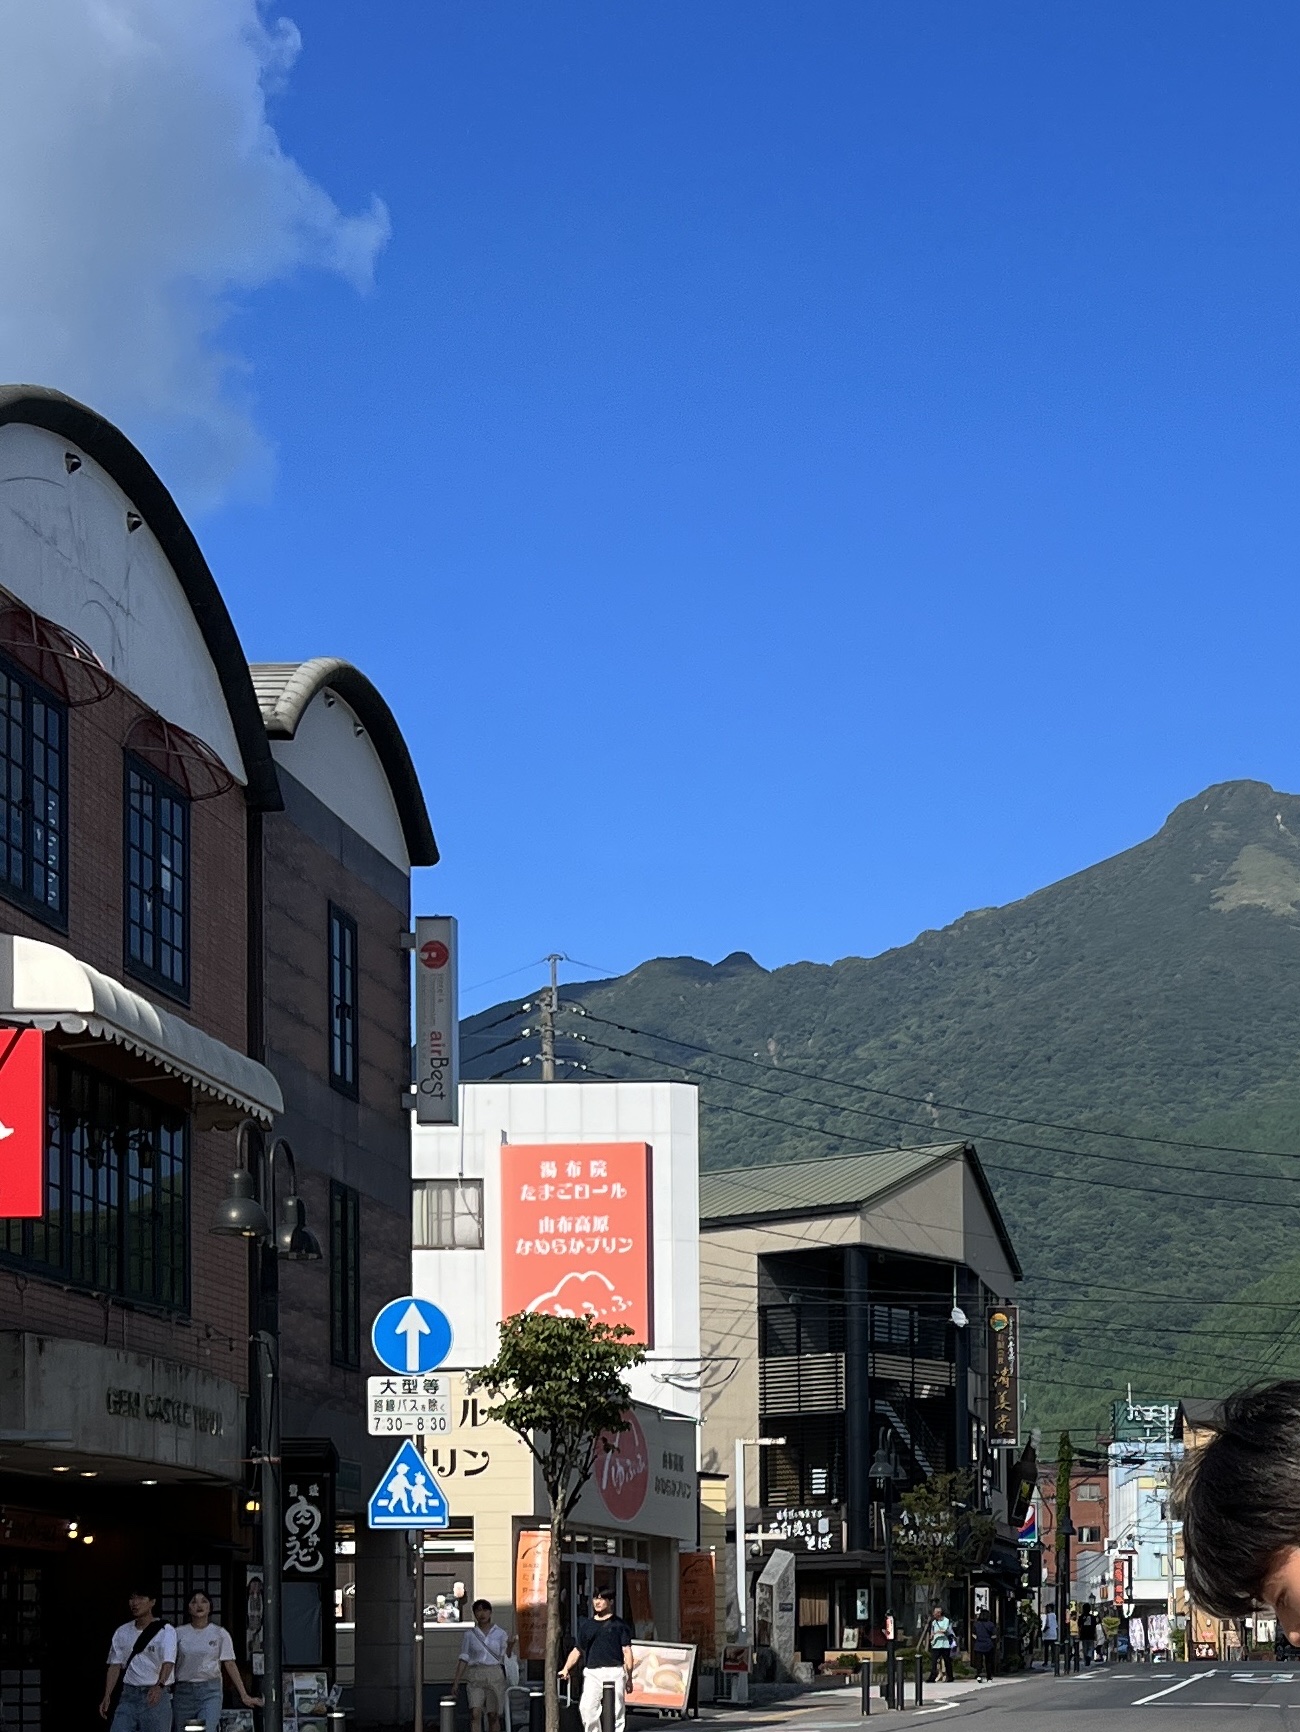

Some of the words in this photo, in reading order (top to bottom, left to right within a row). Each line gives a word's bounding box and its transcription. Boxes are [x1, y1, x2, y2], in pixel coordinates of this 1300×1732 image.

[520, 1182, 628, 1201] たまごロール
[516, 1237, 634, 1256] なめらかプリン
[380, 1378, 440, 1395] 大型等
[373, 1399, 446, 1413] 路線バスを除く
